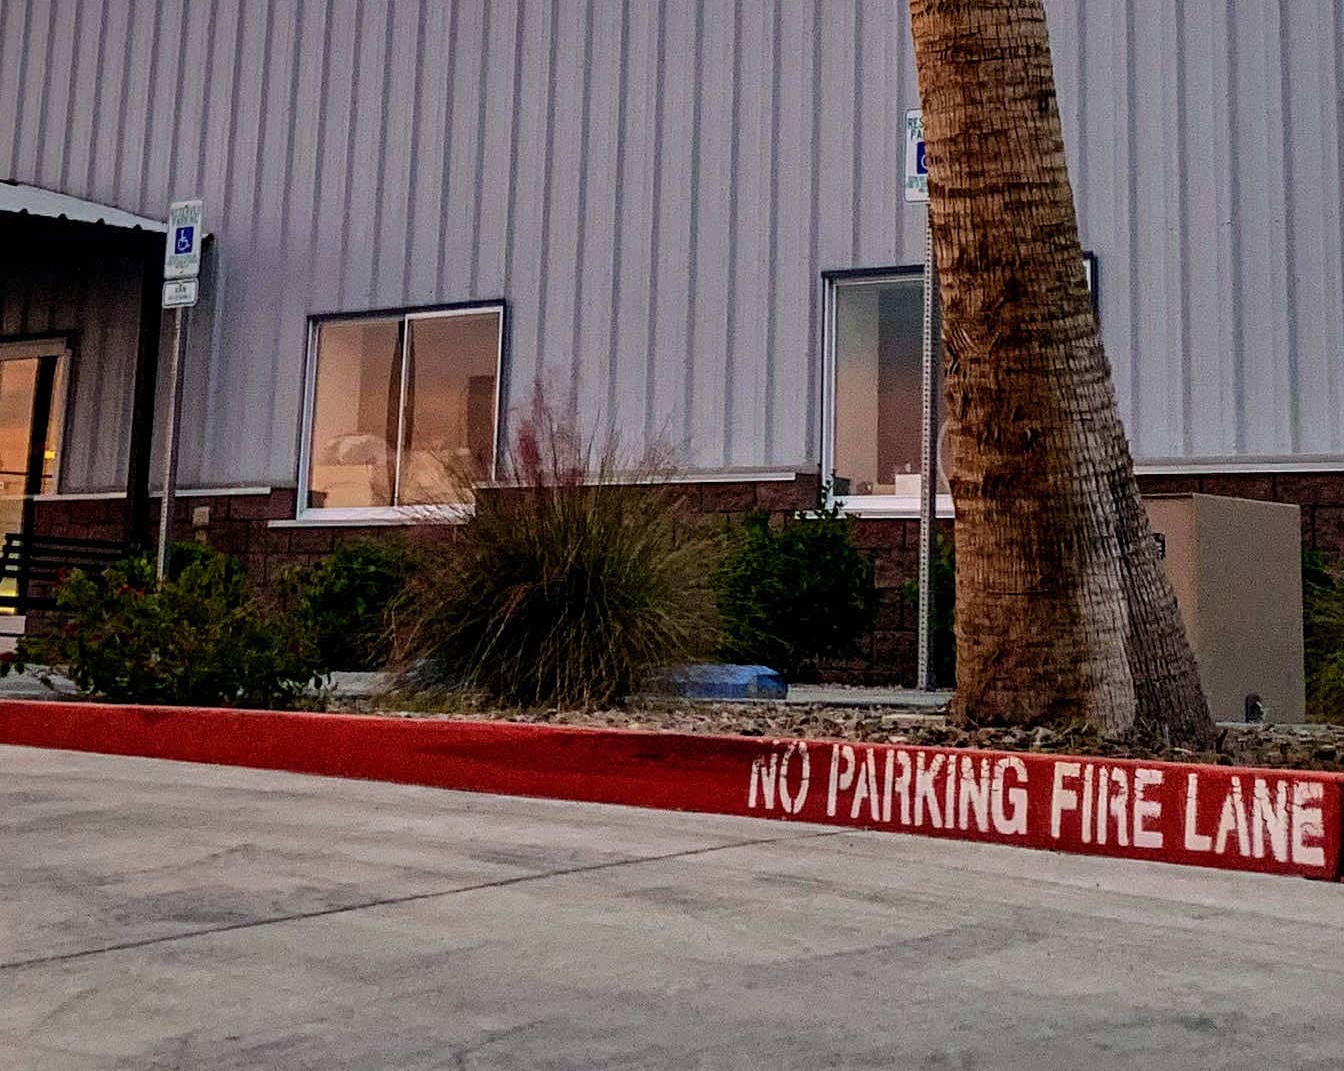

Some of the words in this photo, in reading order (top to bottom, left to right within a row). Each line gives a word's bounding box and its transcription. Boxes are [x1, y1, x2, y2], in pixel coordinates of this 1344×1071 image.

[748, 741, 809, 814] NO
[827, 745, 1028, 835] PARKING
[1051, 761, 1164, 848] FIRE
[1184, 774, 1326, 866] LANE
